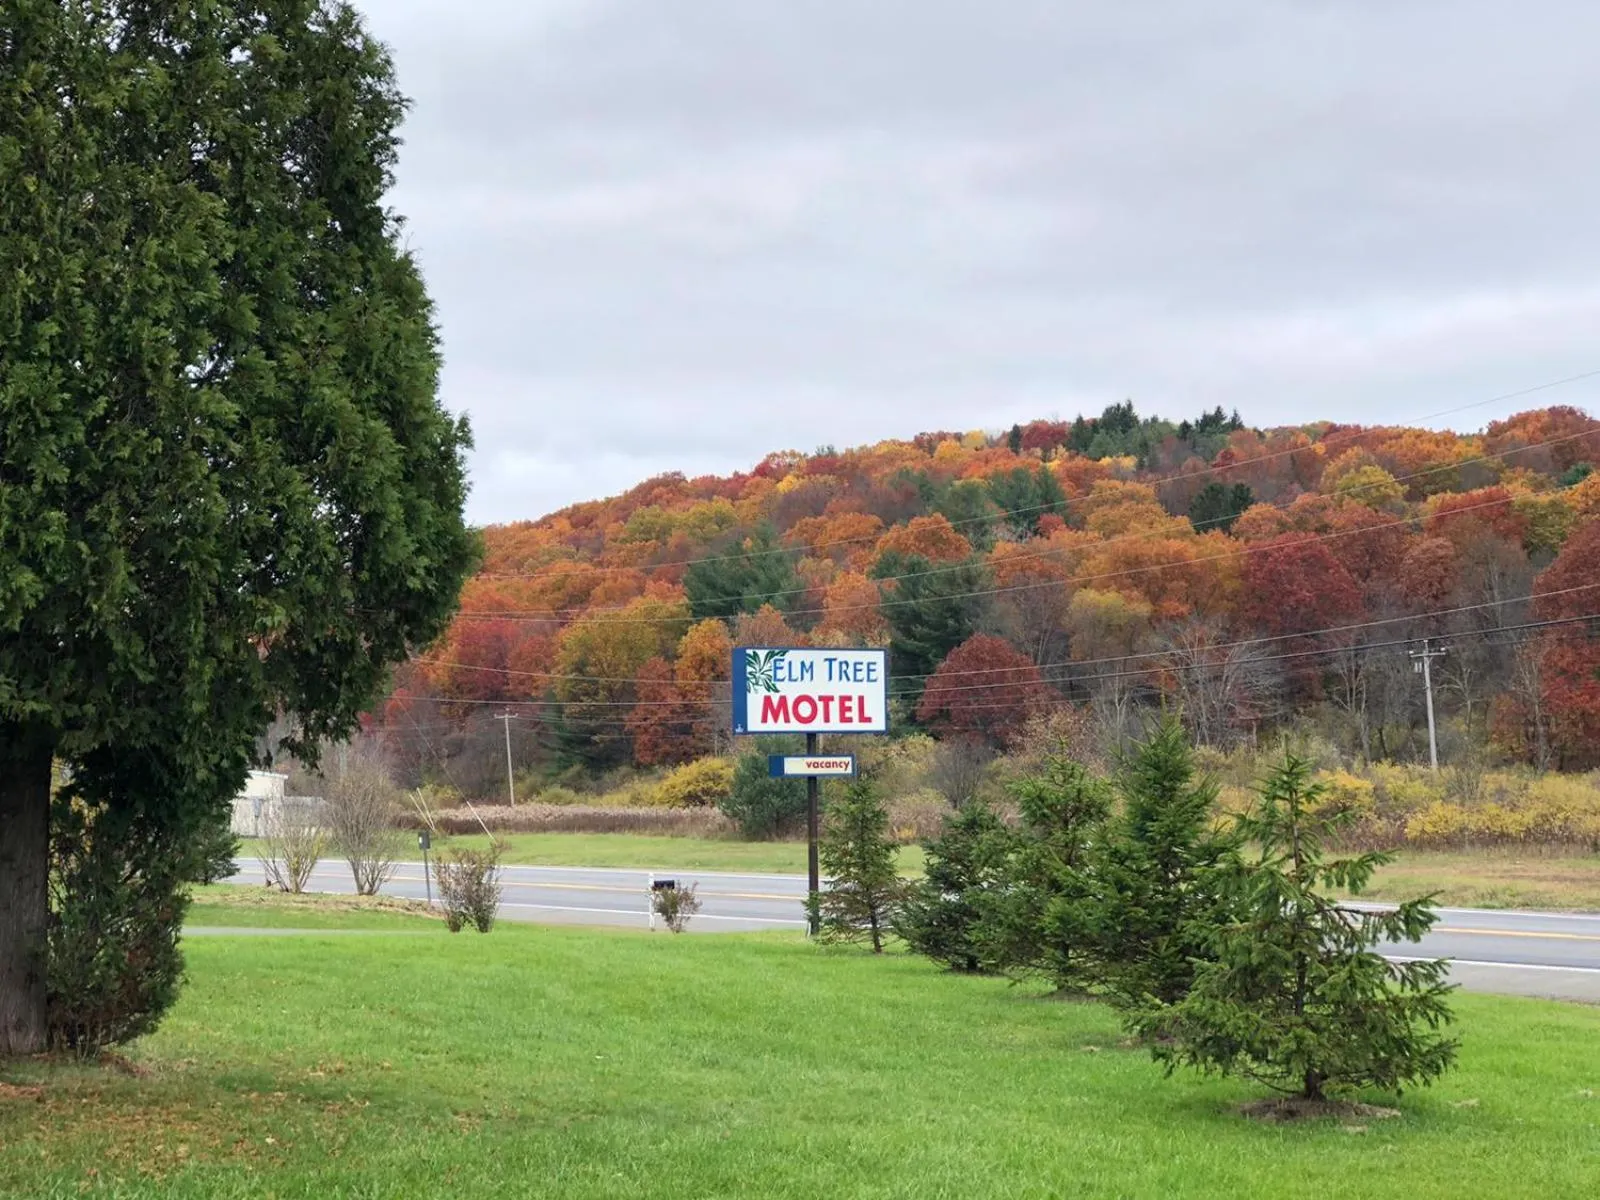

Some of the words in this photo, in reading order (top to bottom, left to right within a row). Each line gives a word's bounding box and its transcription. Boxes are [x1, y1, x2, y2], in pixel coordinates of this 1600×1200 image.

[773, 658, 814, 682] ELM
[824, 658, 878, 682] TREE
[761, 694, 872, 724] MOTEL
[806, 760, 850, 771] vacancy
